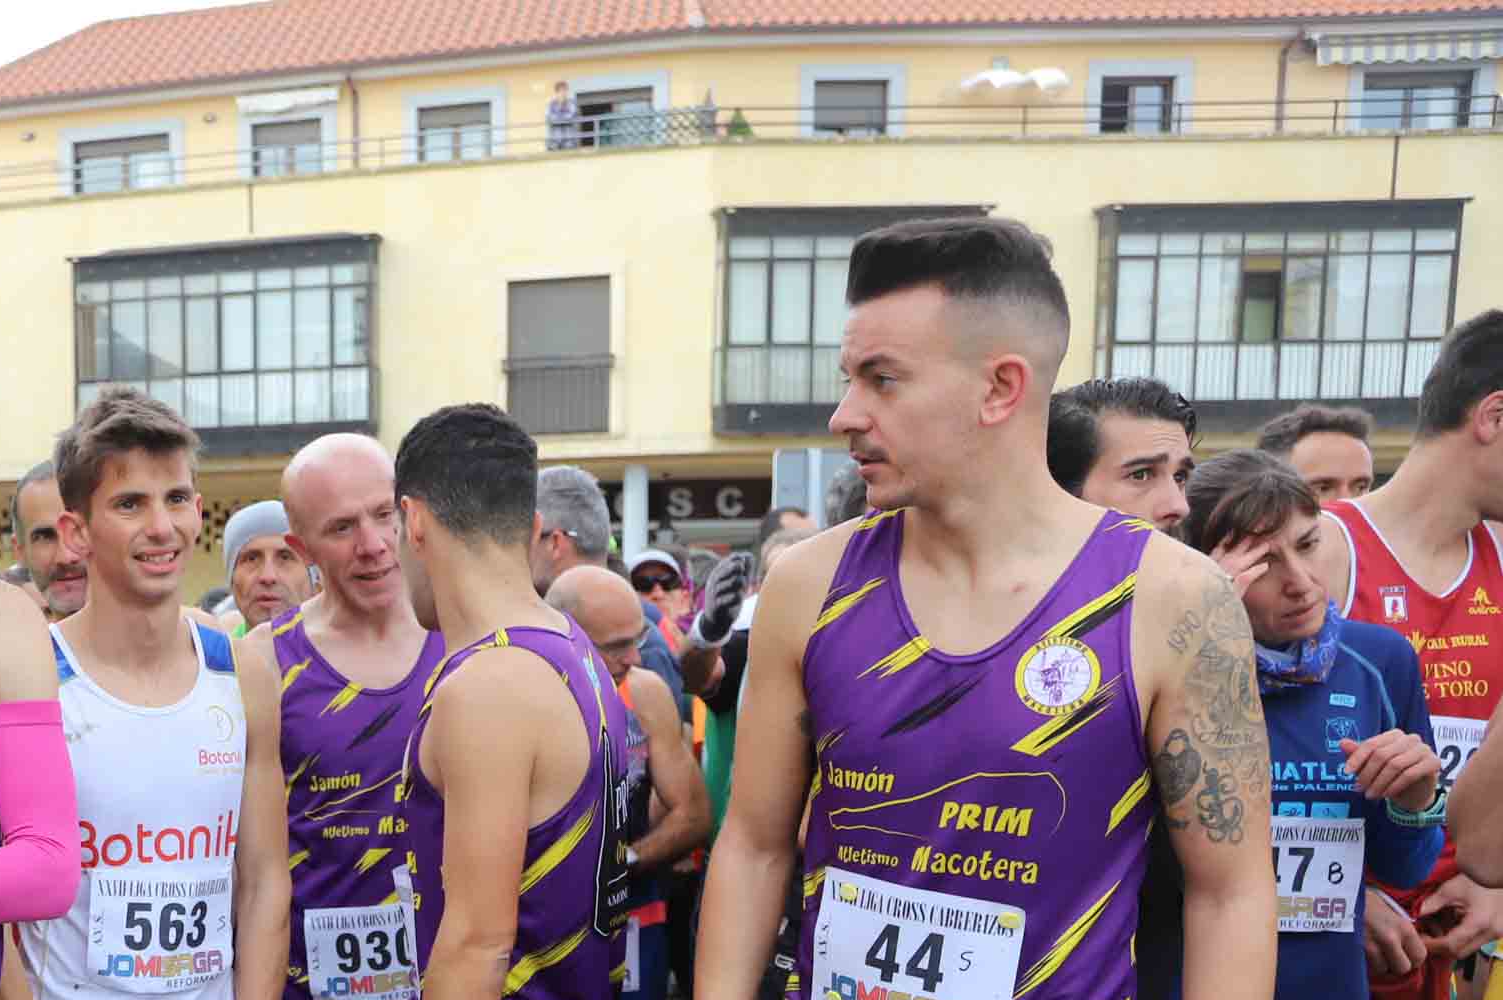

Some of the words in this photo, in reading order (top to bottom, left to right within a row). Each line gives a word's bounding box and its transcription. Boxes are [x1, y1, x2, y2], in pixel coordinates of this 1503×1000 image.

[1434, 679, 1489, 698] TORO
[828, 761, 896, 794] Jamón
[938, 801, 1034, 837] PRIM
[837, 846, 899, 867] Atletismo
[911, 846, 1039, 885] Macotera
[1272, 846, 1315, 892] 7
[129, 879, 153, 897] LIGA
[155, 878, 187, 897] CROSS
[860, 886, 884, 912] LIGA
[886, 893, 927, 924] CROSS
[124, 901, 208, 951] 563
[97, 950, 224, 978] JOMISAGA
[865, 924, 944, 993] 44
[958, 951, 974, 973] S
